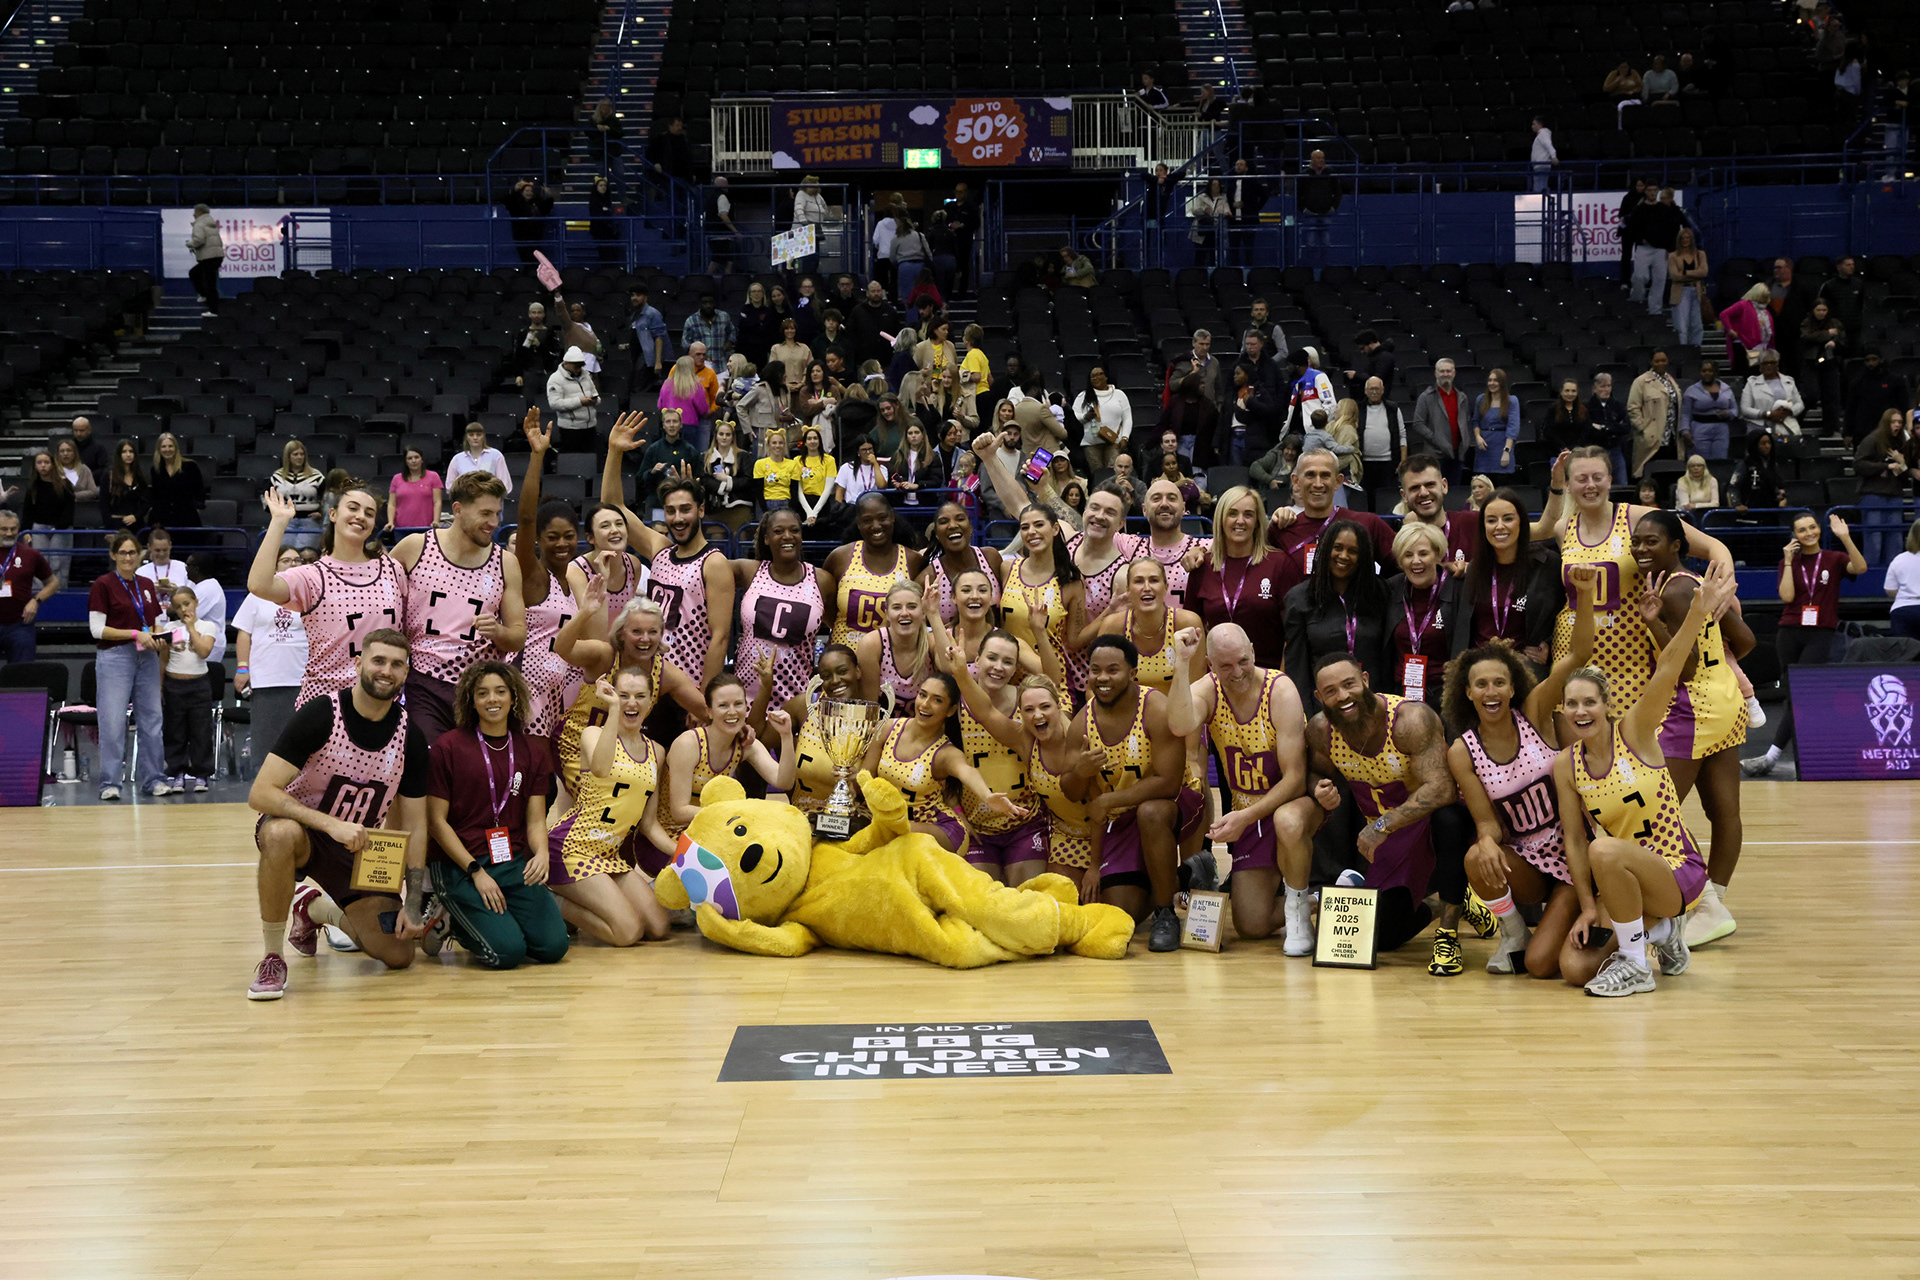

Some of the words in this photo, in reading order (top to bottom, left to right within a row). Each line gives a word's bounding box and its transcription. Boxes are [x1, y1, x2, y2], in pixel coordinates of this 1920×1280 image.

[787, 104, 882, 126] STUDENT
[970, 103, 982, 113] UP
[986, 101, 1001, 111] TO
[793, 124, 880, 145] SEASON
[955, 113, 1019, 144] 50%
[802, 143, 873, 163] TICKET
[972, 143, 1003, 159] OFF
[1578, 203, 1621, 225] ilita
[216, 219, 274, 241] ilita
[225, 243, 275, 261] ena
[220, 264, 276, 272] MINGHAM
[857, 594, 886, 629] GS
[771, 602, 793, 639] C
[1862, 748, 1920, 759] NETBAL
[1234, 751, 1270, 791] GK
[328, 784, 376, 824] GA
[1502, 782, 1554, 833] WD
[374, 840, 403, 848] NETBALL
[1198, 900, 1220, 908] NETBALL
[1334, 896, 1374, 906] NETBALL
[1334, 904, 1350, 913] AID
[1336, 914, 1359, 923] 2025
[1333, 925, 1359, 936] MVP
[779, 1047, 1110, 1063] CHILDREN
[814, 1063, 881, 1076] IN
[903, 1060, 1080, 1074] NEED
